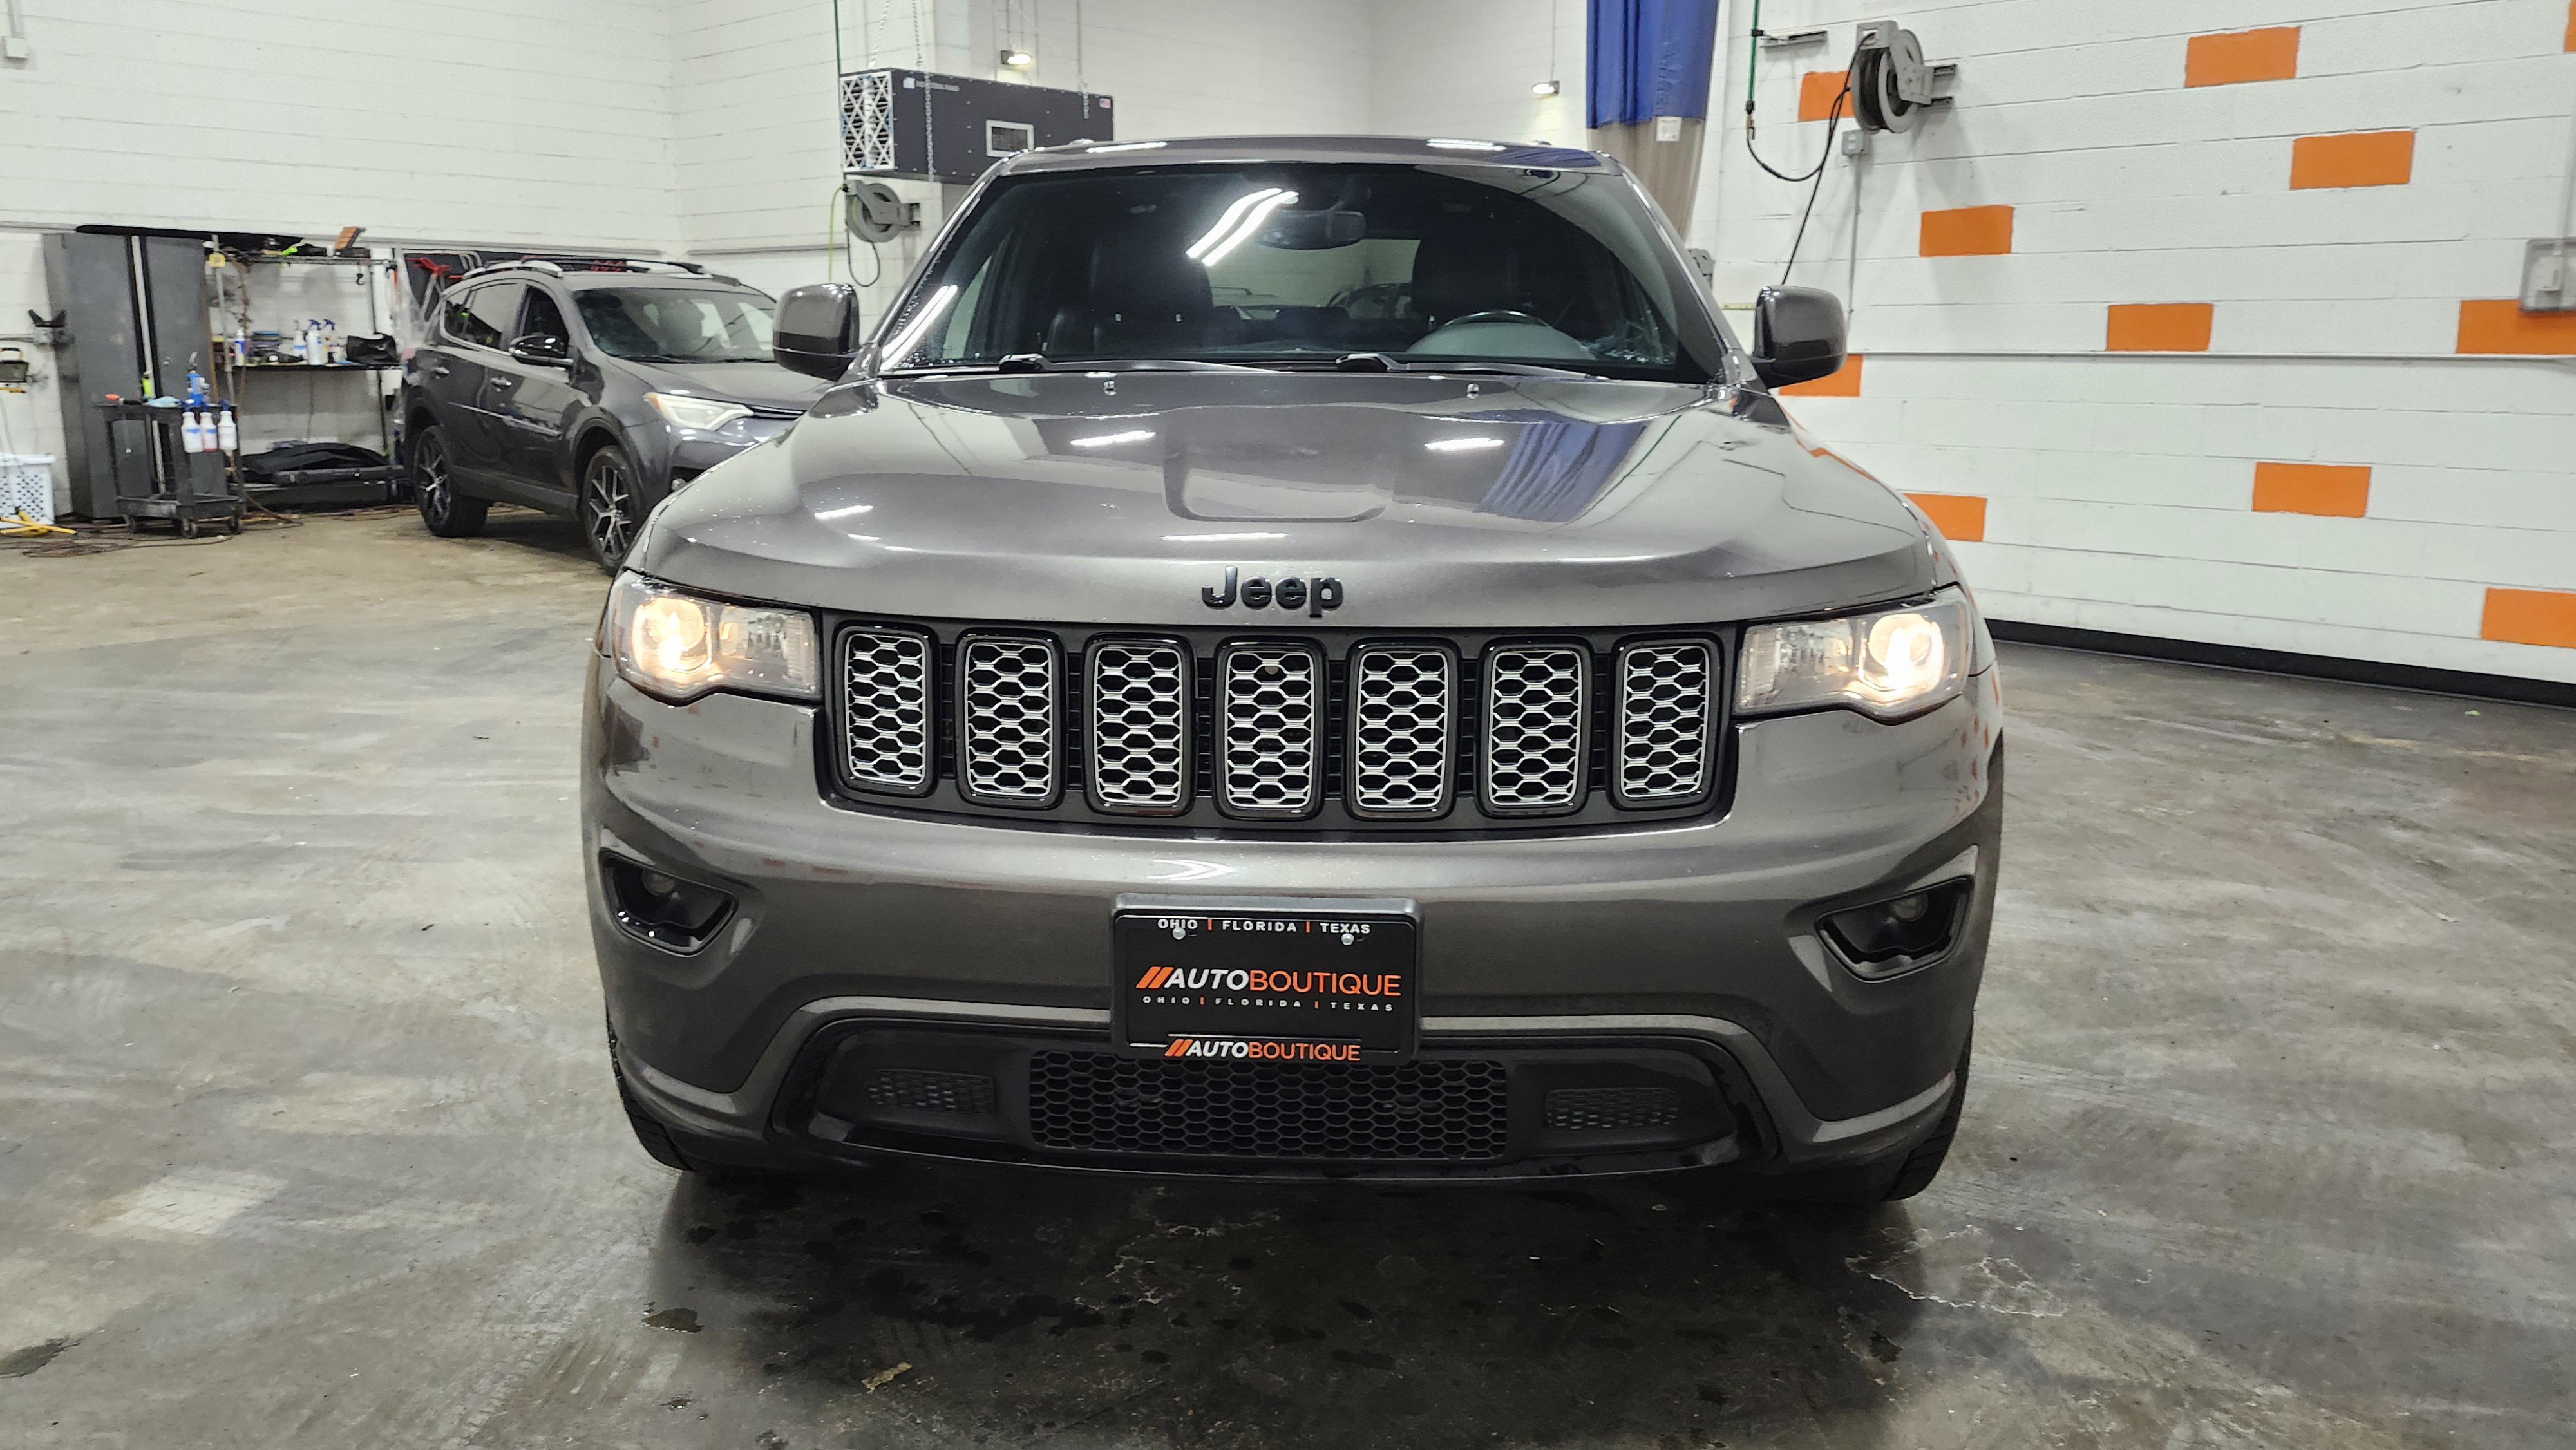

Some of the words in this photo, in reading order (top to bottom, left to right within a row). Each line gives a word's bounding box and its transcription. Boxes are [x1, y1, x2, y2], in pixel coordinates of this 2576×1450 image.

[1202, 565, 1343, 618] Jeep
[1157, 919, 1198, 930] OHIO
[1222, 920, 1298, 932] FLORIDA
[1320, 922, 1371, 934] TEXAS
[1163, 967, 1402, 997] AUTOBOUTIQUE
[1142, 995, 1191, 1005] OHIO
[1215, 997, 1302, 1008] FLORIDA
[1330, 1001, 1394, 1012] TEXAS
[1186, 1039, 1361, 1062] AUTOBOUTIQUE
